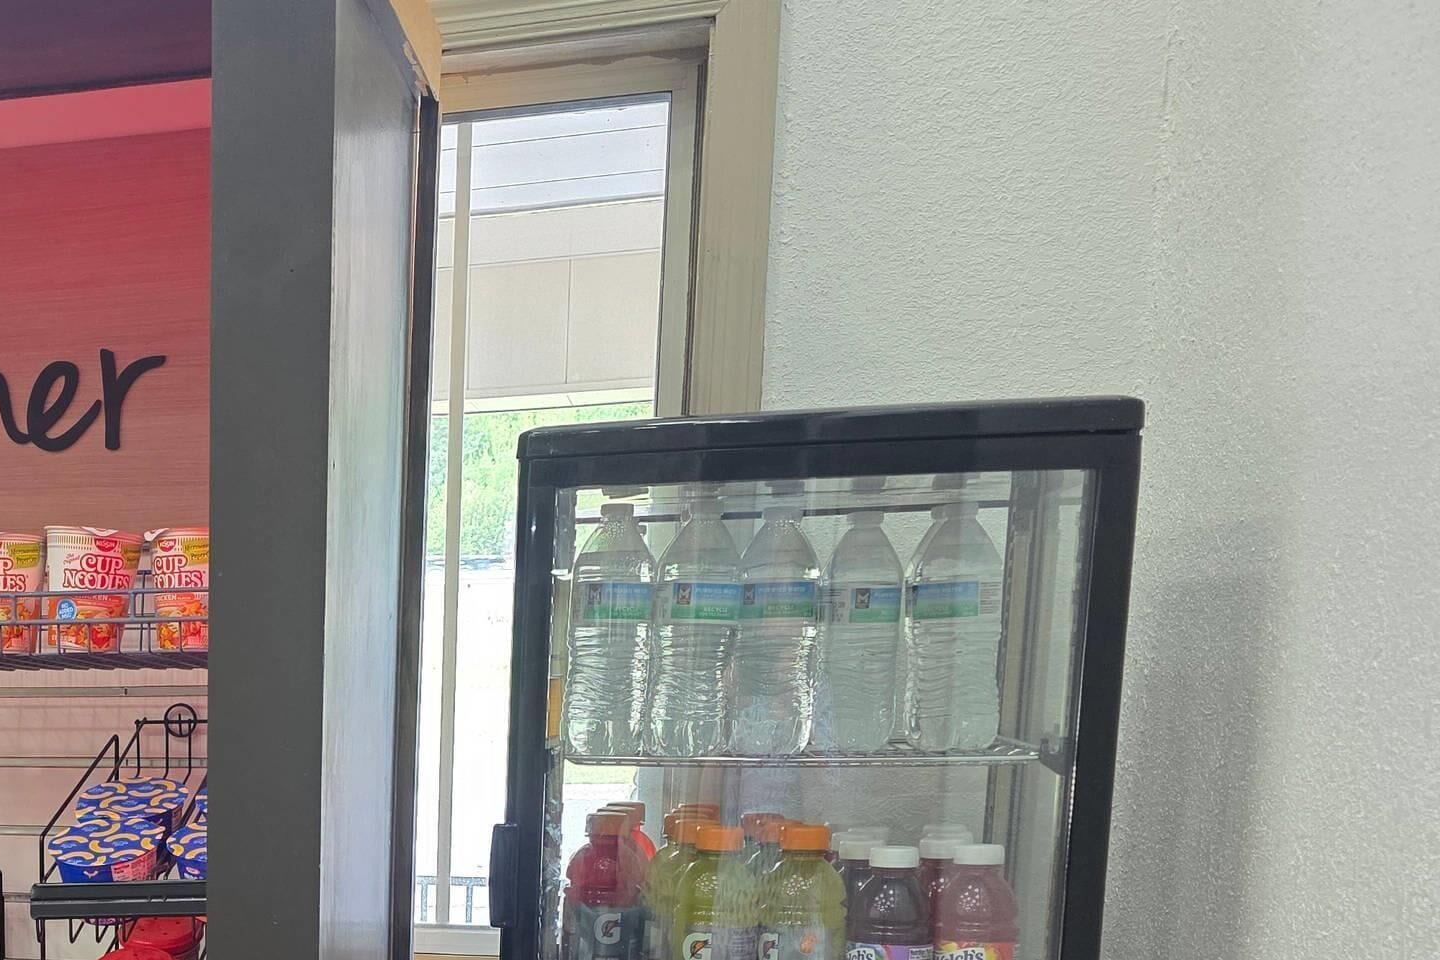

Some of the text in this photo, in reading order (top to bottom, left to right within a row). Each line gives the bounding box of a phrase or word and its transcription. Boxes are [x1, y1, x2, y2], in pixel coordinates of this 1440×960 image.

[80, 553, 124, 574] CUP
[154, 554, 188, 573] CUP
[63, 570, 130, 590] NOODLES
[594, 913, 622, 945] G
